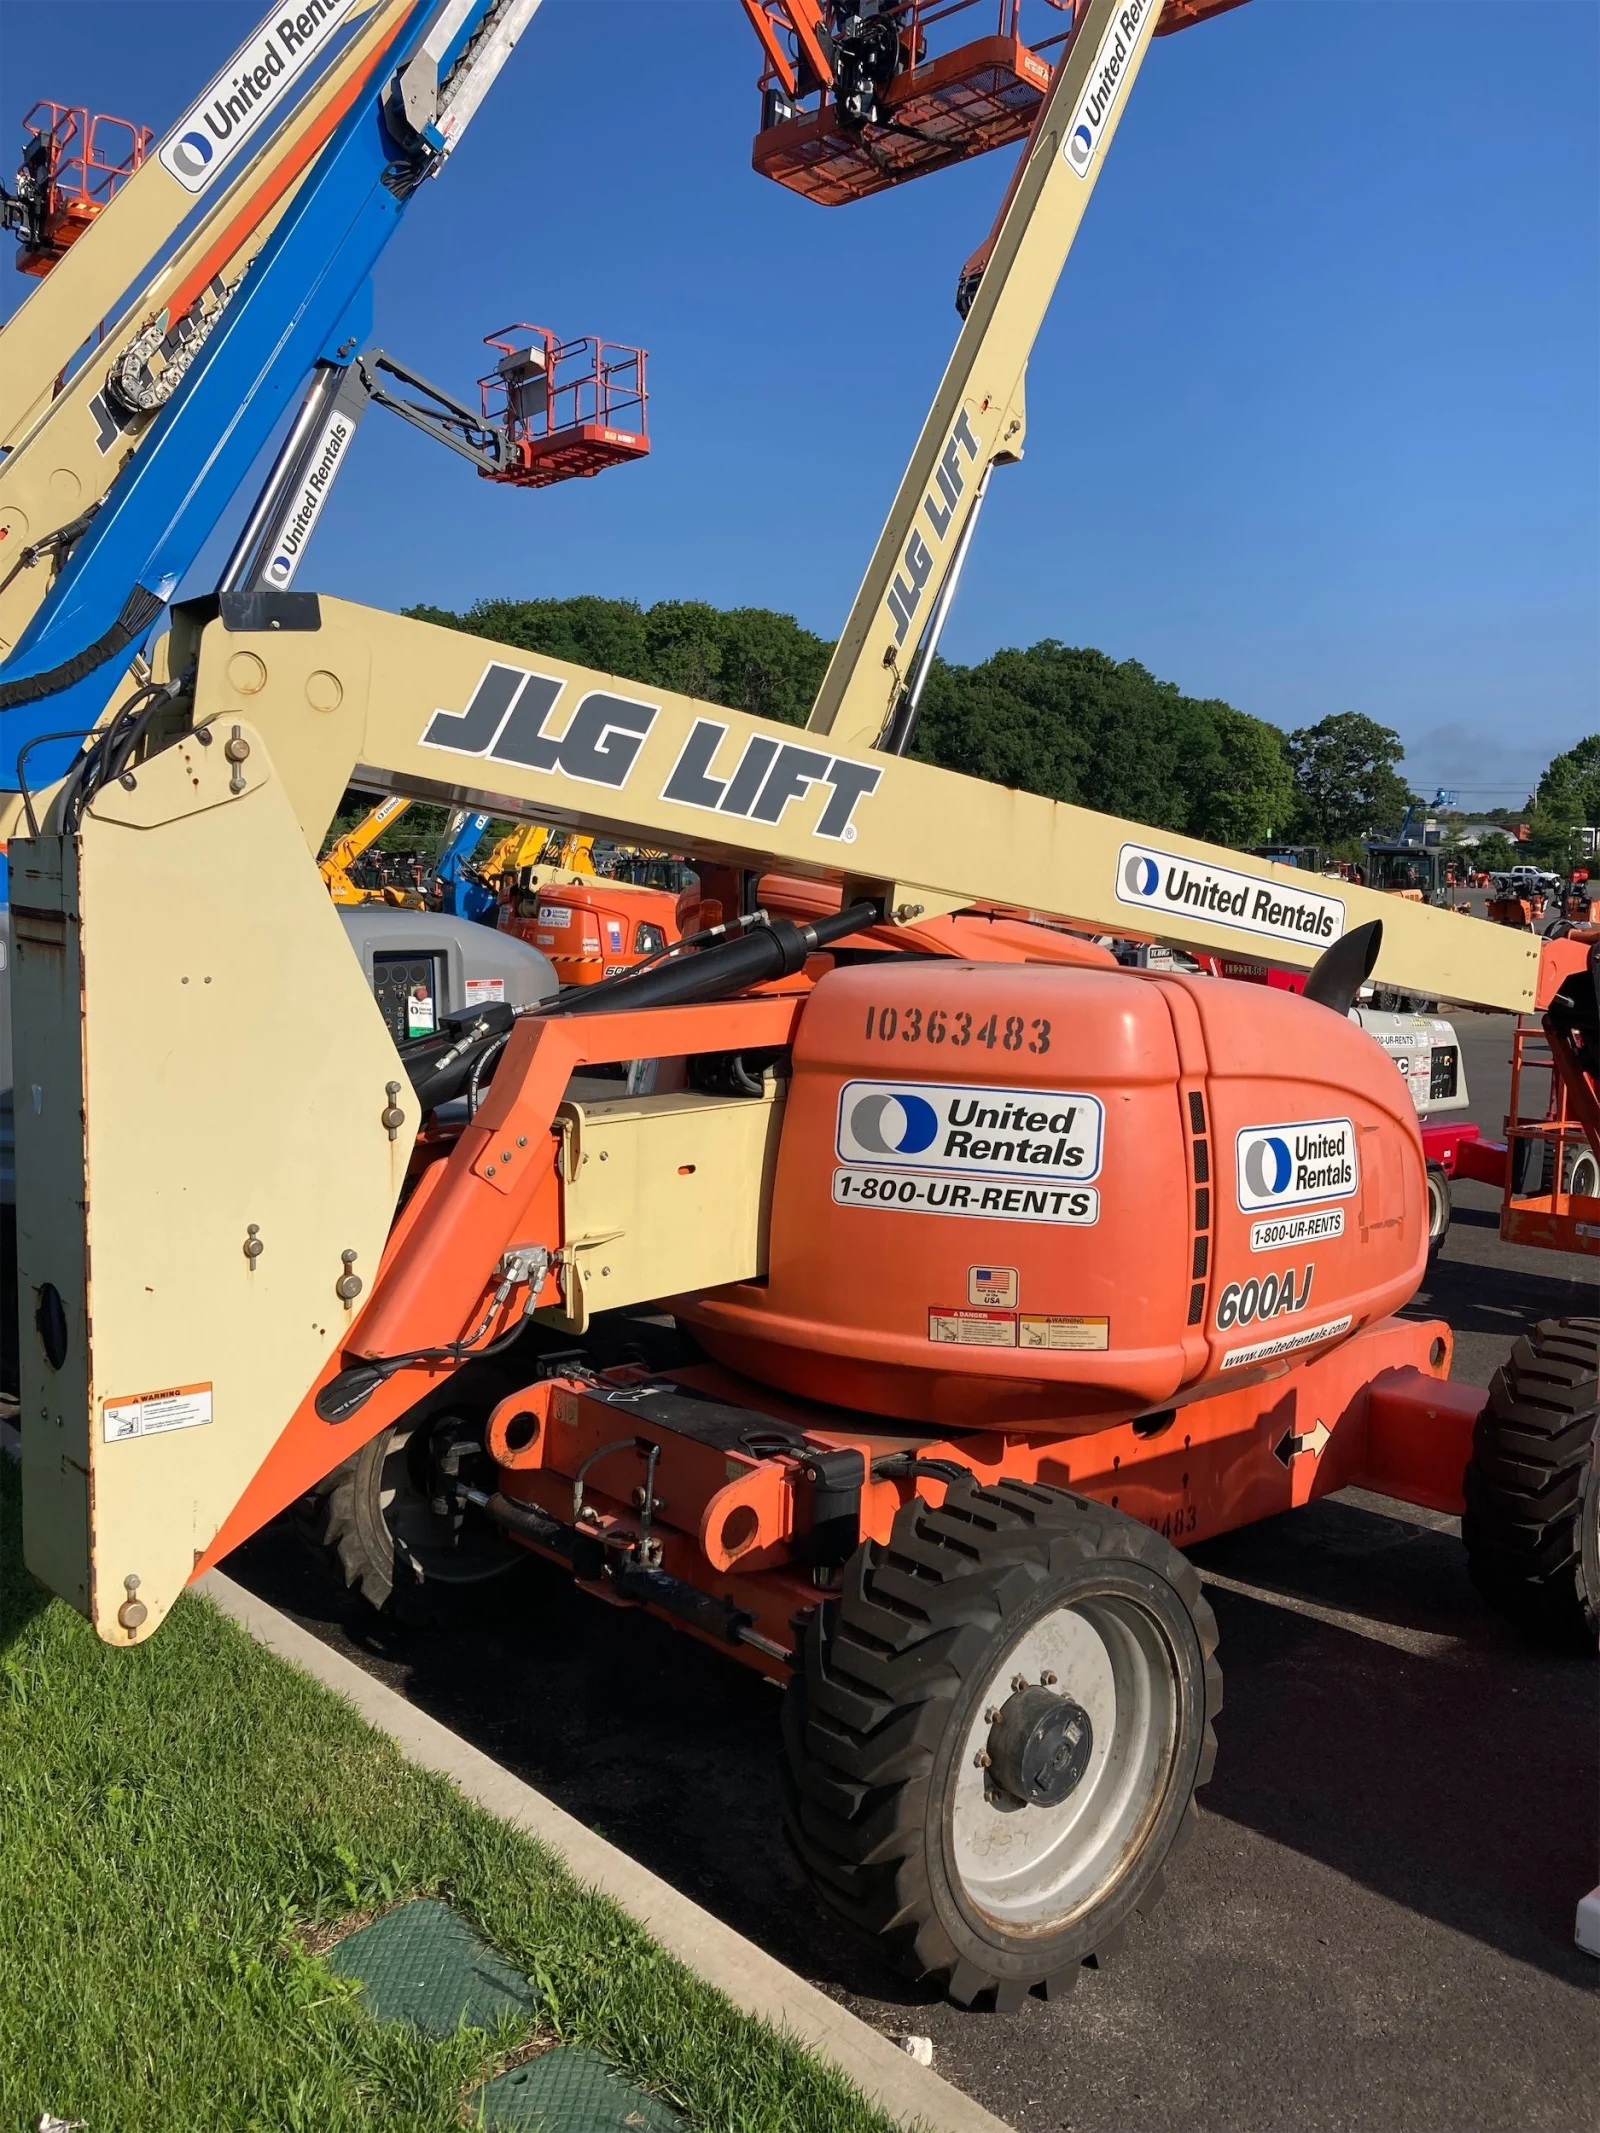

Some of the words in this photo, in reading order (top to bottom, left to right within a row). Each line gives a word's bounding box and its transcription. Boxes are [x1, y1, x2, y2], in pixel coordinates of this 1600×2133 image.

[203, 40, 285, 140] United
[276, 0, 340, 56] Rent
[1085, 33, 1127, 127] United
[282, 491, 318, 555] United
[309, 424, 347, 493] Rentals
[887, 526, 933, 648] JLG
[923, 406, 978, 543] LIFT
[419, 660, 661, 789] JLG
[658, 717, 885, 841] LIFT
[1165, 867, 1249, 917] United
[1252, 890, 1333, 937] Rentals
[865, 1006, 1051, 1054] 10363483
[948, 1099, 1076, 1134] United
[943, 1130, 1085, 1167] Rentals
[1295, 1131, 1345, 1161] United
[1296, 1159, 1352, 1190] Rentals
[840, 1176, 1090, 1217] 1-800-UR-RENTS
[1255, 1214, 1341, 1244] 1-800-UR-RENTS
[959, 1311, 988, 1319] DANGER
[984, 1296, 1000, 1304] USA
[1217, 1265, 1314, 1330] 600AJ
[1225, 1321, 1348, 1367] www.unitedrentals.com
[140, 1390, 181, 1402] WARNING
